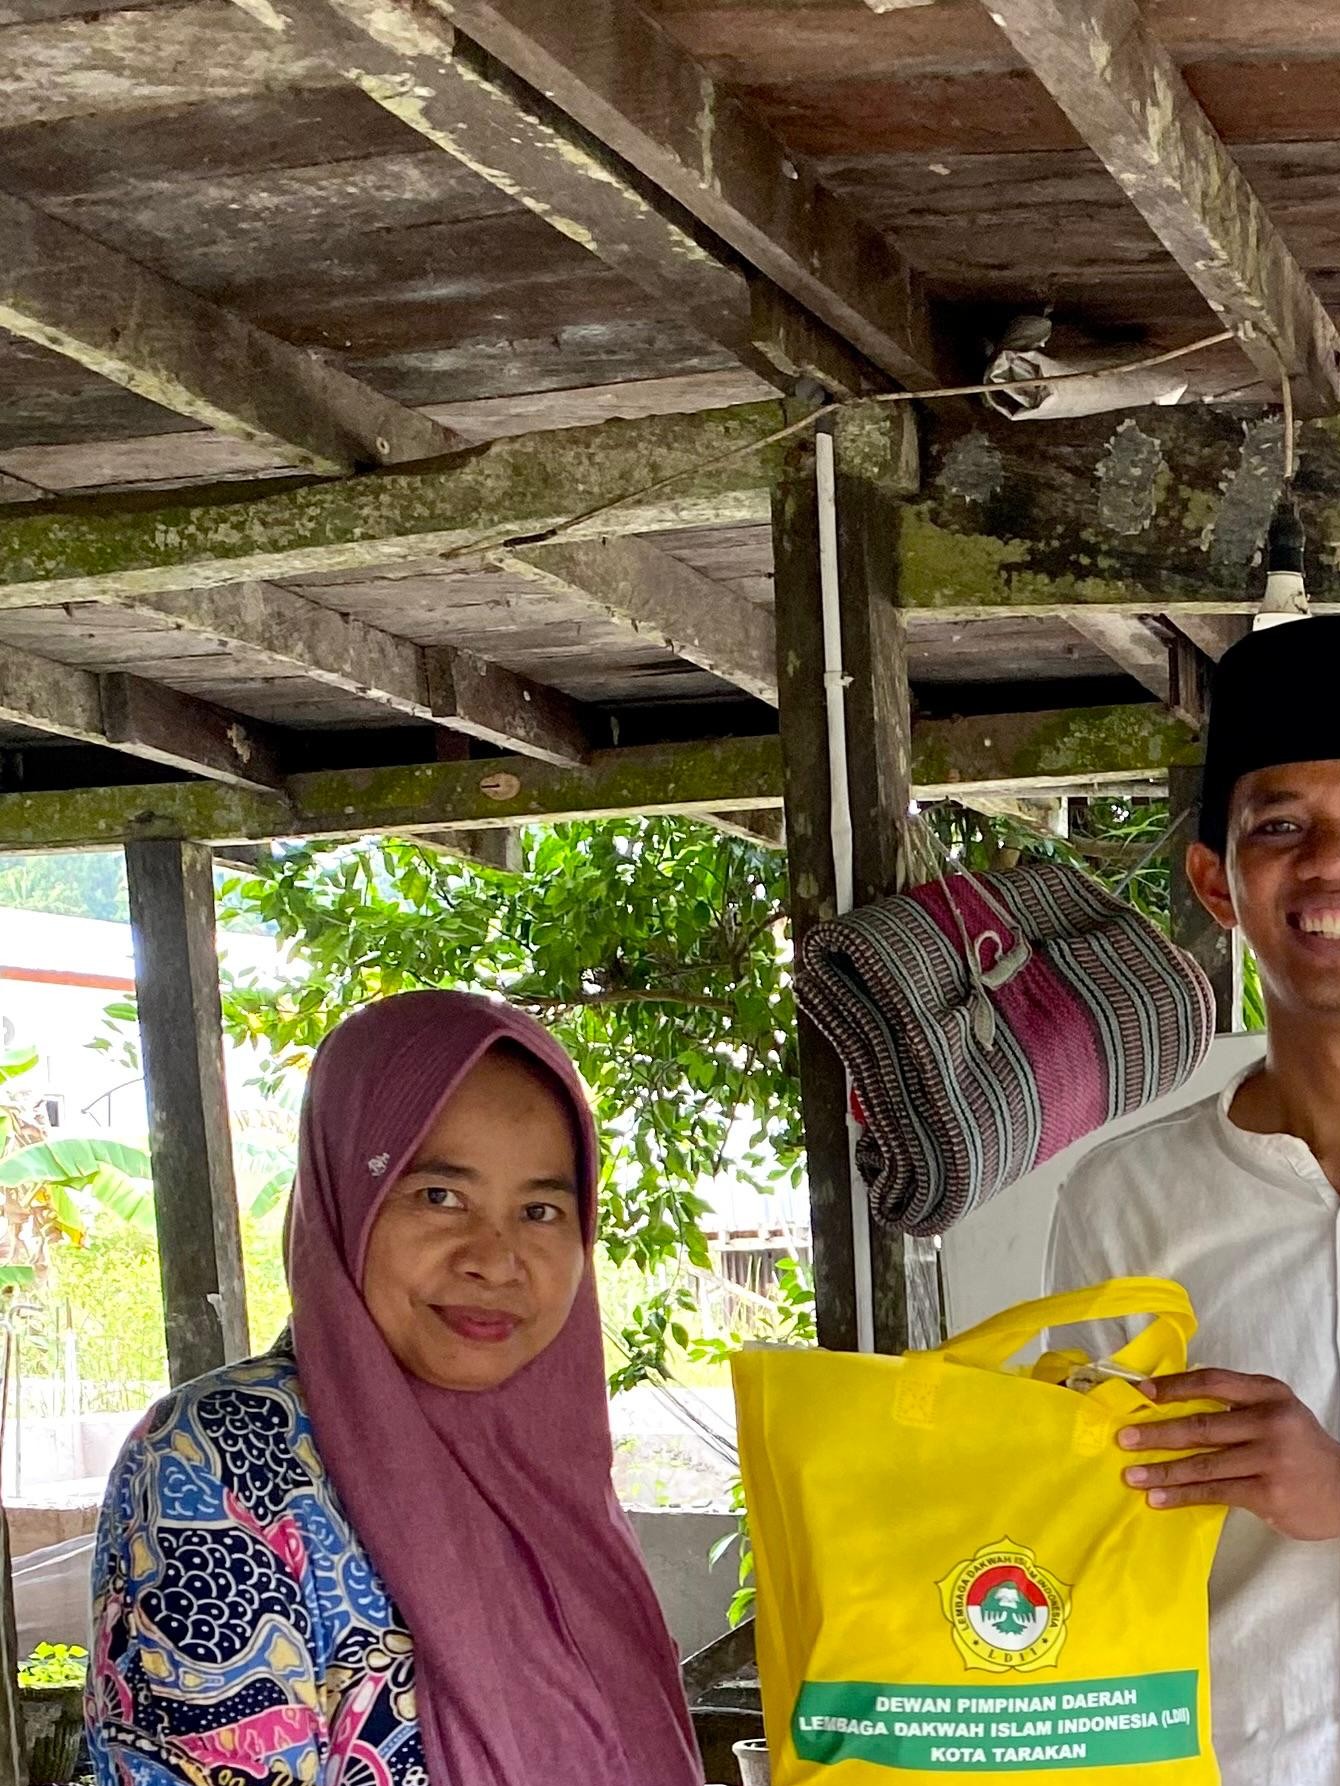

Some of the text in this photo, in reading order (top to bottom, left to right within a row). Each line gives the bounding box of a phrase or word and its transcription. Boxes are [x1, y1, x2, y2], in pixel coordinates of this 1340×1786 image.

[966, 1556, 1011, 1578] DAKWAH
[875, 1689, 1137, 1714] DEWAN PIMPINAN DAERAH
[799, 1707, 1190, 1737] LEMBAGA DAKWAH ISLAM INDONESIA (LDII)
[930, 1743, 1086, 1762] KOTA TARAKAN
